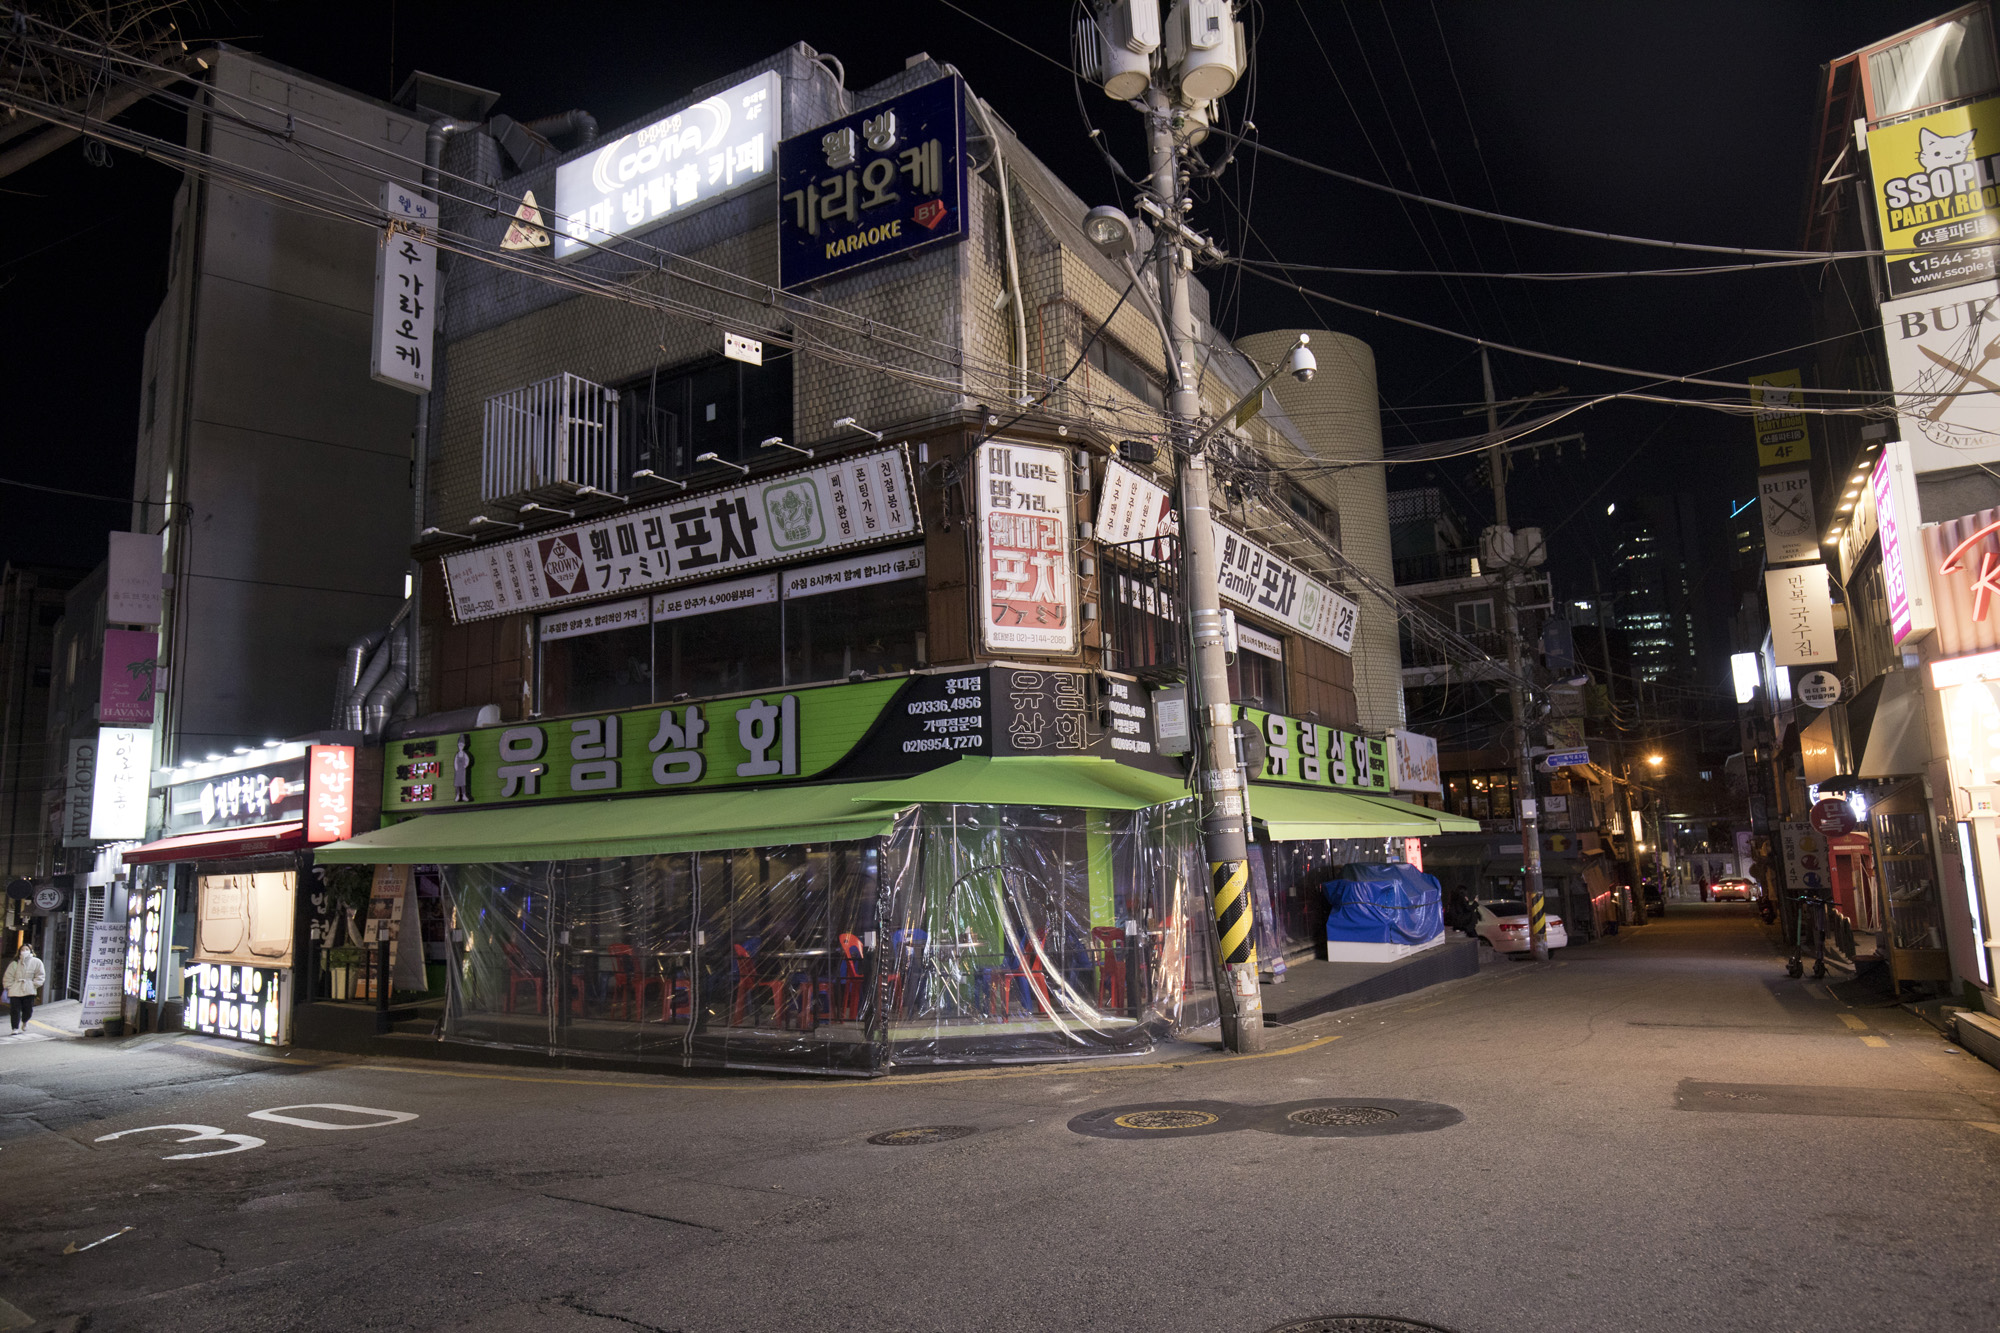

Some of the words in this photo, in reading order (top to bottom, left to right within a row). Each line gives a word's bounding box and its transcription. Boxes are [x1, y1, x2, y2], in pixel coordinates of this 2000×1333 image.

[618, 125, 702, 182] COMA
[564, 197, 615, 248] 코마
[622, 162, 701, 226] 방탈출
[708, 132, 765, 186] 카페
[783, 138, 943, 236] 가라오케
[918, 203, 936, 221] B1
[1889, 198, 1950, 230] PARTY
[1954, 186, 2000, 216] ROO
[826, 219, 902, 260] KARAOKE
[395, 240, 425, 369] 주가라오케
[1780, 417, 1803, 430] ROOM
[988, 447, 1012, 477] 비
[1014, 461, 1058, 483] 내리는
[1774, 445, 1794, 459] 4F
[855, 467, 876, 530] 폰팅가능
[880, 461, 901, 524] 친절봉사
[989, 478, 1015, 508] 밤
[1762, 478, 1808, 496] BURP
[588, 515, 667, 562] 훼미리
[669, 496, 759, 572] 포차
[989, 514, 1063, 553] 훼미리
[546, 556, 581, 576] CROWN
[556, 572, 576, 583] 크라운
[595, 549, 671, 589] ファミリ
[791, 578, 808, 592] 아침
[809, 571, 842, 588] 8시까지
[843, 568, 862, 582] 함께
[863, 563, 891, 579] 합니다
[892, 557, 921, 574] (금,토)
[991, 550, 1069, 605] 포차
[1217, 563, 1258, 603] Family
[1222, 534, 1263, 580] 훼미리
[1257, 558, 1298, 617] 포차
[594, 610, 622, 627] 합리적인
[666, 601, 683, 614] 모든
[684, 596, 708, 611] 안주가
[1786, 573, 1814, 658] 만복국수집
[1015, 633, 1067, 645] 02)-3144-2080
[1336, 606, 1354, 643] 2층
[944, 676, 982, 695] 홍대점
[1009, 670, 1085, 711] 유림
[1805, 692, 1837, 701] 방탈출카페
[103, 708, 152, 718] HAVANA
[907, 696, 982, 716] 02)336.4956
[922, 715, 983, 734] 가맹점문의
[497, 694, 801, 798] 유림상회
[902, 734, 983, 754] 02)6954.7270
[1008, 712, 1088, 750] 상회
[74, 744, 94, 793] CHOP
[1264, 712, 1371, 788] 유림상회
[316, 750, 352, 836] 김밥천국
[71, 794, 91, 840] HAIR
[1783, 823, 1794, 831] LA
[38, 891, 58, 902] 초밥
[93, 924, 107, 932] NAIL
[91, 957, 114, 967] 이달의
[80, 1018, 94, 1027] NAIL
[94, 1102, 420, 1160] 30
